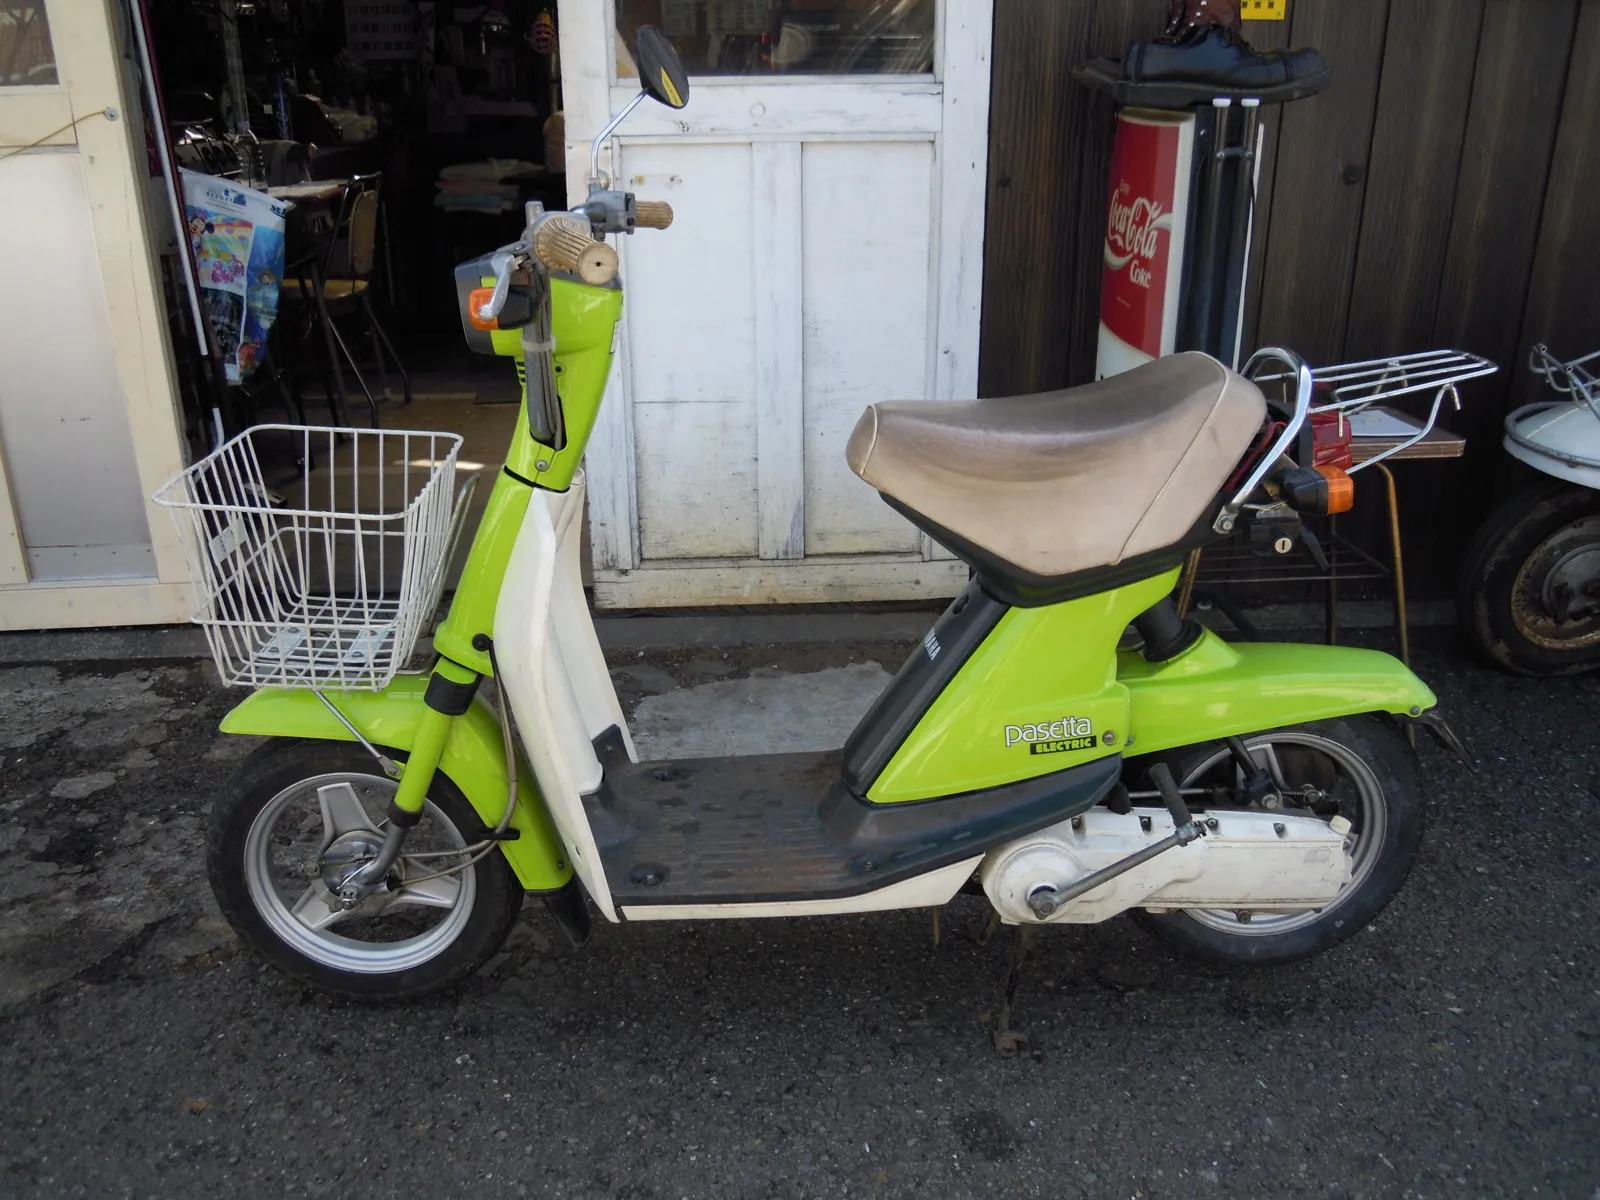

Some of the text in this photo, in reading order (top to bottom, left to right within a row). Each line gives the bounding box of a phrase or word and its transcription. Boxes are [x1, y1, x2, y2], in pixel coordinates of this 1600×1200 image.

[1108, 187, 1162, 259] Coca-Cola
[1130, 260, 1151, 288] Coke
[1005, 716, 1092, 748] pasetta
[1035, 738, 1092, 753] ELECTRIC
